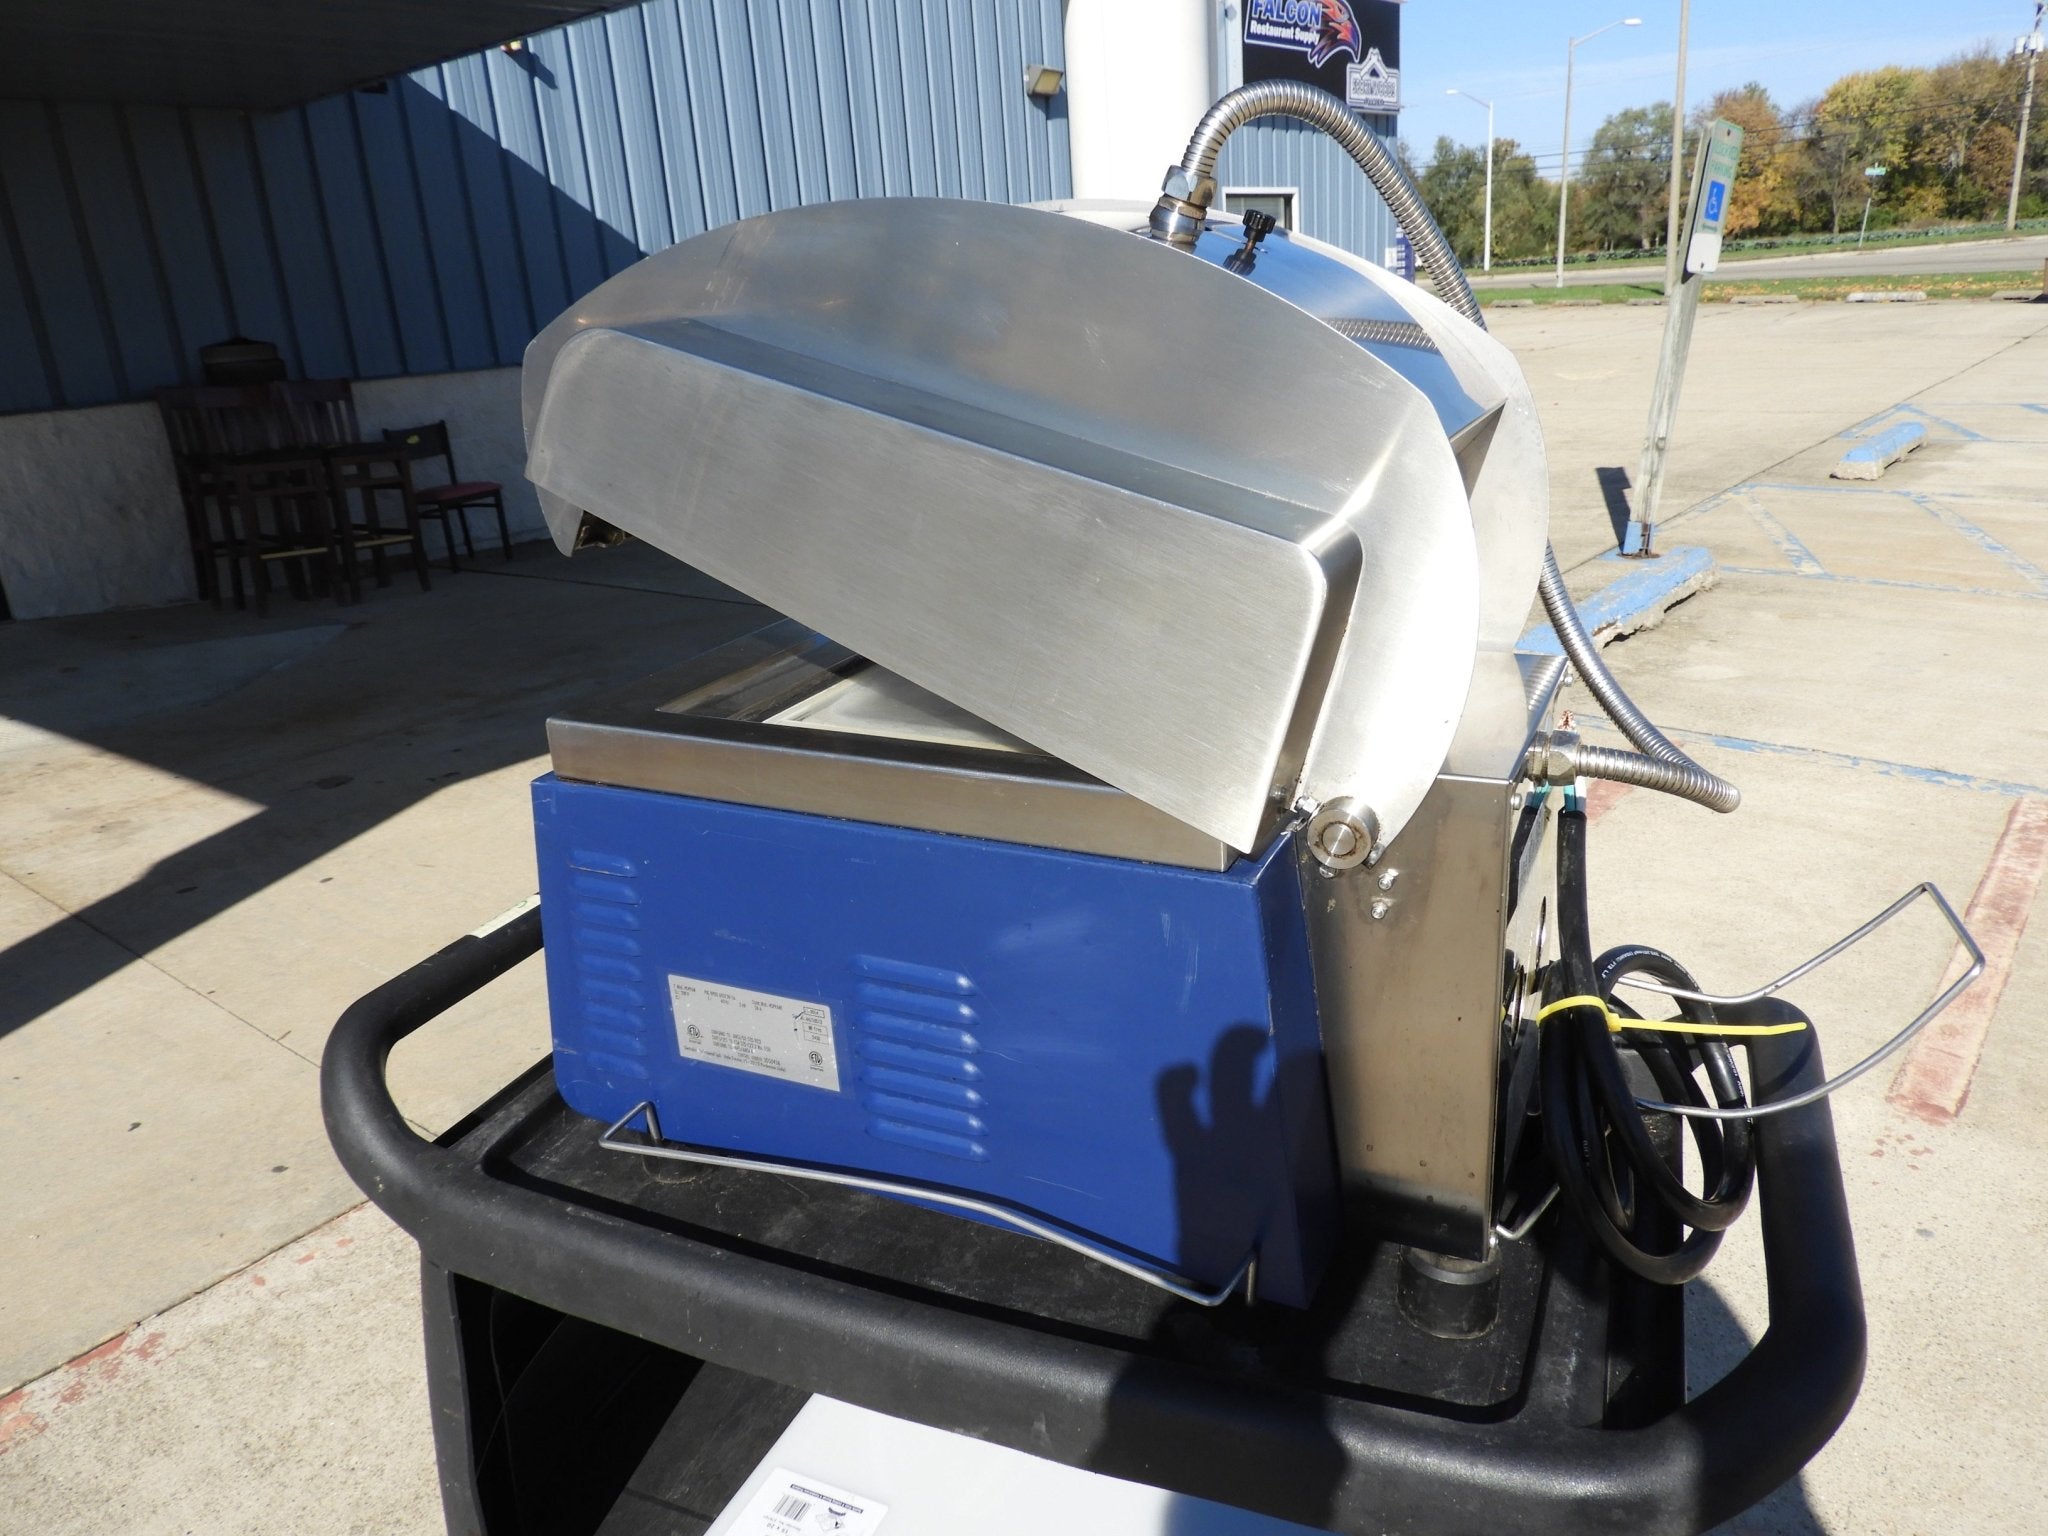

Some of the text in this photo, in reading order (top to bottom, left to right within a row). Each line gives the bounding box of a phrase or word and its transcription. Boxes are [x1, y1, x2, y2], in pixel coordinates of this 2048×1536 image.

[1252, 0, 1322, 28] FALCON
[1250, 20, 1320, 46] Restaurant Supply
